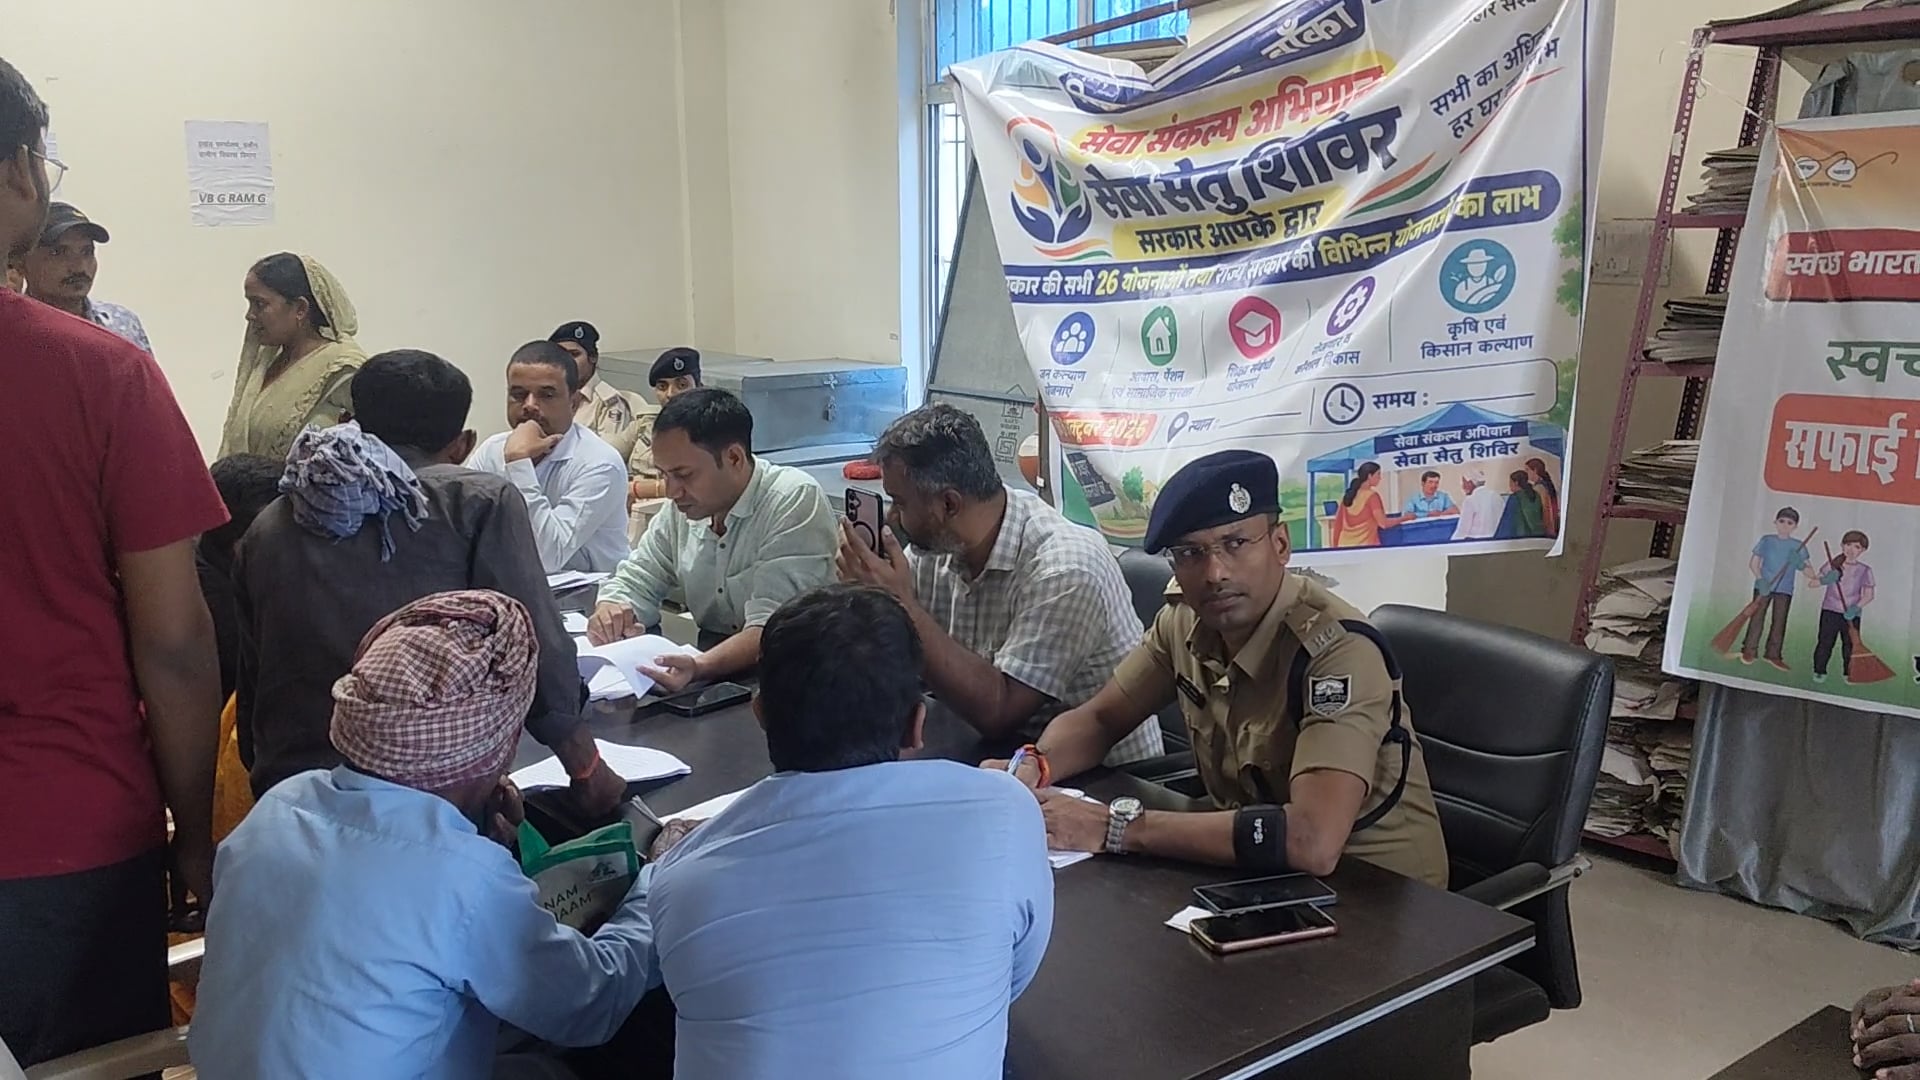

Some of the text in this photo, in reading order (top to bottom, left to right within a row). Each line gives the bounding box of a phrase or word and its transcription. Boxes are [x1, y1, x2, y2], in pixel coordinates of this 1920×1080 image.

[1430, 74, 1471, 117] सभी
[1474, 60, 1500, 88] का
[1448, 108, 1474, 139] हर
[1477, 89, 1503, 118] घर
[1080, 125, 1147, 156] सेवा
[1146, 113, 1242, 153] संकल्प
[199, 193, 266, 203] VB G RAM G
[1084, 163, 1167, 219] सेवा
[1158, 158, 1250, 216] सेतु
[1005, 275, 1041, 296] कार
[1041, 269, 1063, 296] की
[1064, 268, 1095, 296] सभी
[1095, 269, 1120, 296] 26
[1121, 263, 1189, 293] योजनाओं
[1247, 251, 1292, 279] सरकार
[1290, 241, 1315, 271] की
[1318, 231, 1392, 267] विभिन्न
[1455, 192, 1487, 219] का
[1492, 184, 1543, 215] लाभ
[1135, 200, 1325, 255] सरकार आपके द्वार
[1785, 249, 1920, 276] स्वच्छ भारत
[1447, 314, 1507, 341] कृषि एवं
[1420, 334, 1534, 360] किसान कल्याण
[1371, 390, 1417, 410] समय
[1102, 416, 1148, 439] 2026
[1393, 440, 1521, 468] सेवा सेतु शिविर
[1784, 411, 1908, 485] सफाई
